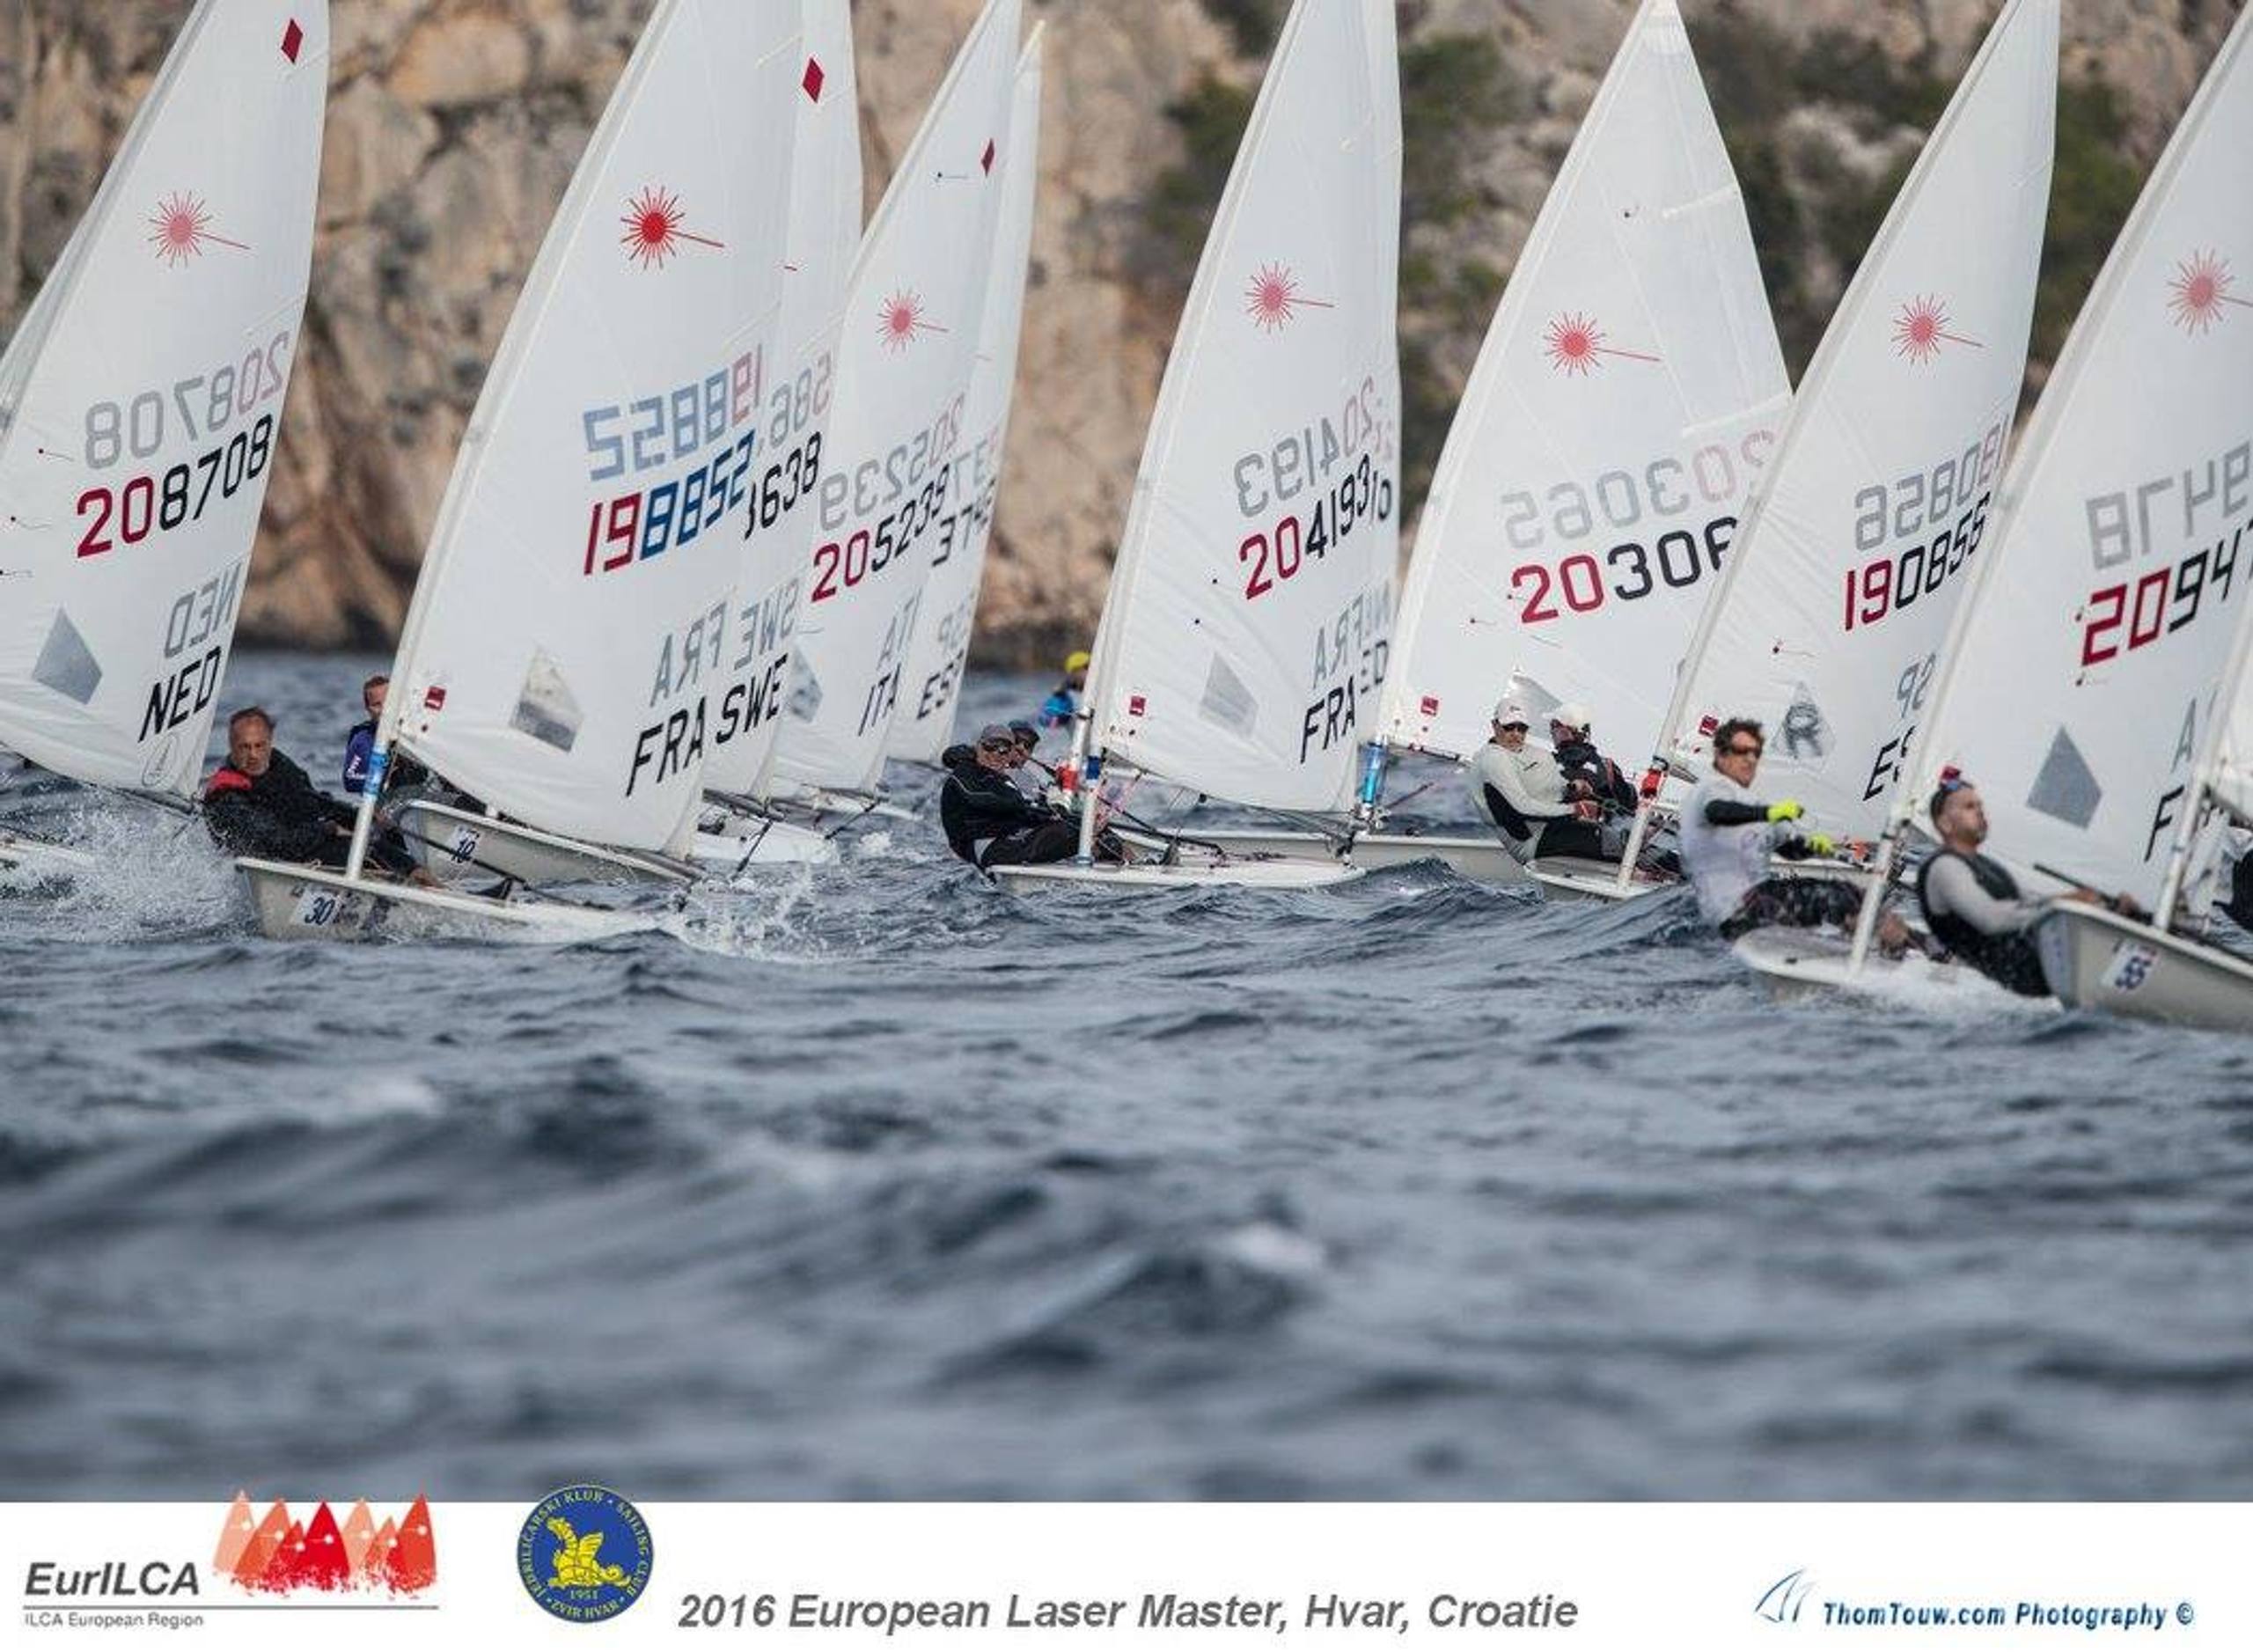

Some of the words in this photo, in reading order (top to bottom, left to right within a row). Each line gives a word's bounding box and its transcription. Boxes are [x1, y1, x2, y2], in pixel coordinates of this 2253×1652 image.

[77, 414, 273, 559] 208708
[584, 430, 756, 575] 198852
[811, 464, 950, 602] 205239
[1239, 453, 1369, 600] 204193
[1845, 491, 1990, 631] 190856
[137, 646, 222, 744] NED
[716, 653, 789, 745] SWE
[858, 663, 902, 737] ITA
[1299, 676, 1356, 764] FRA
[626, 696, 707, 797] FRA
[304, 897, 335, 926] 30
